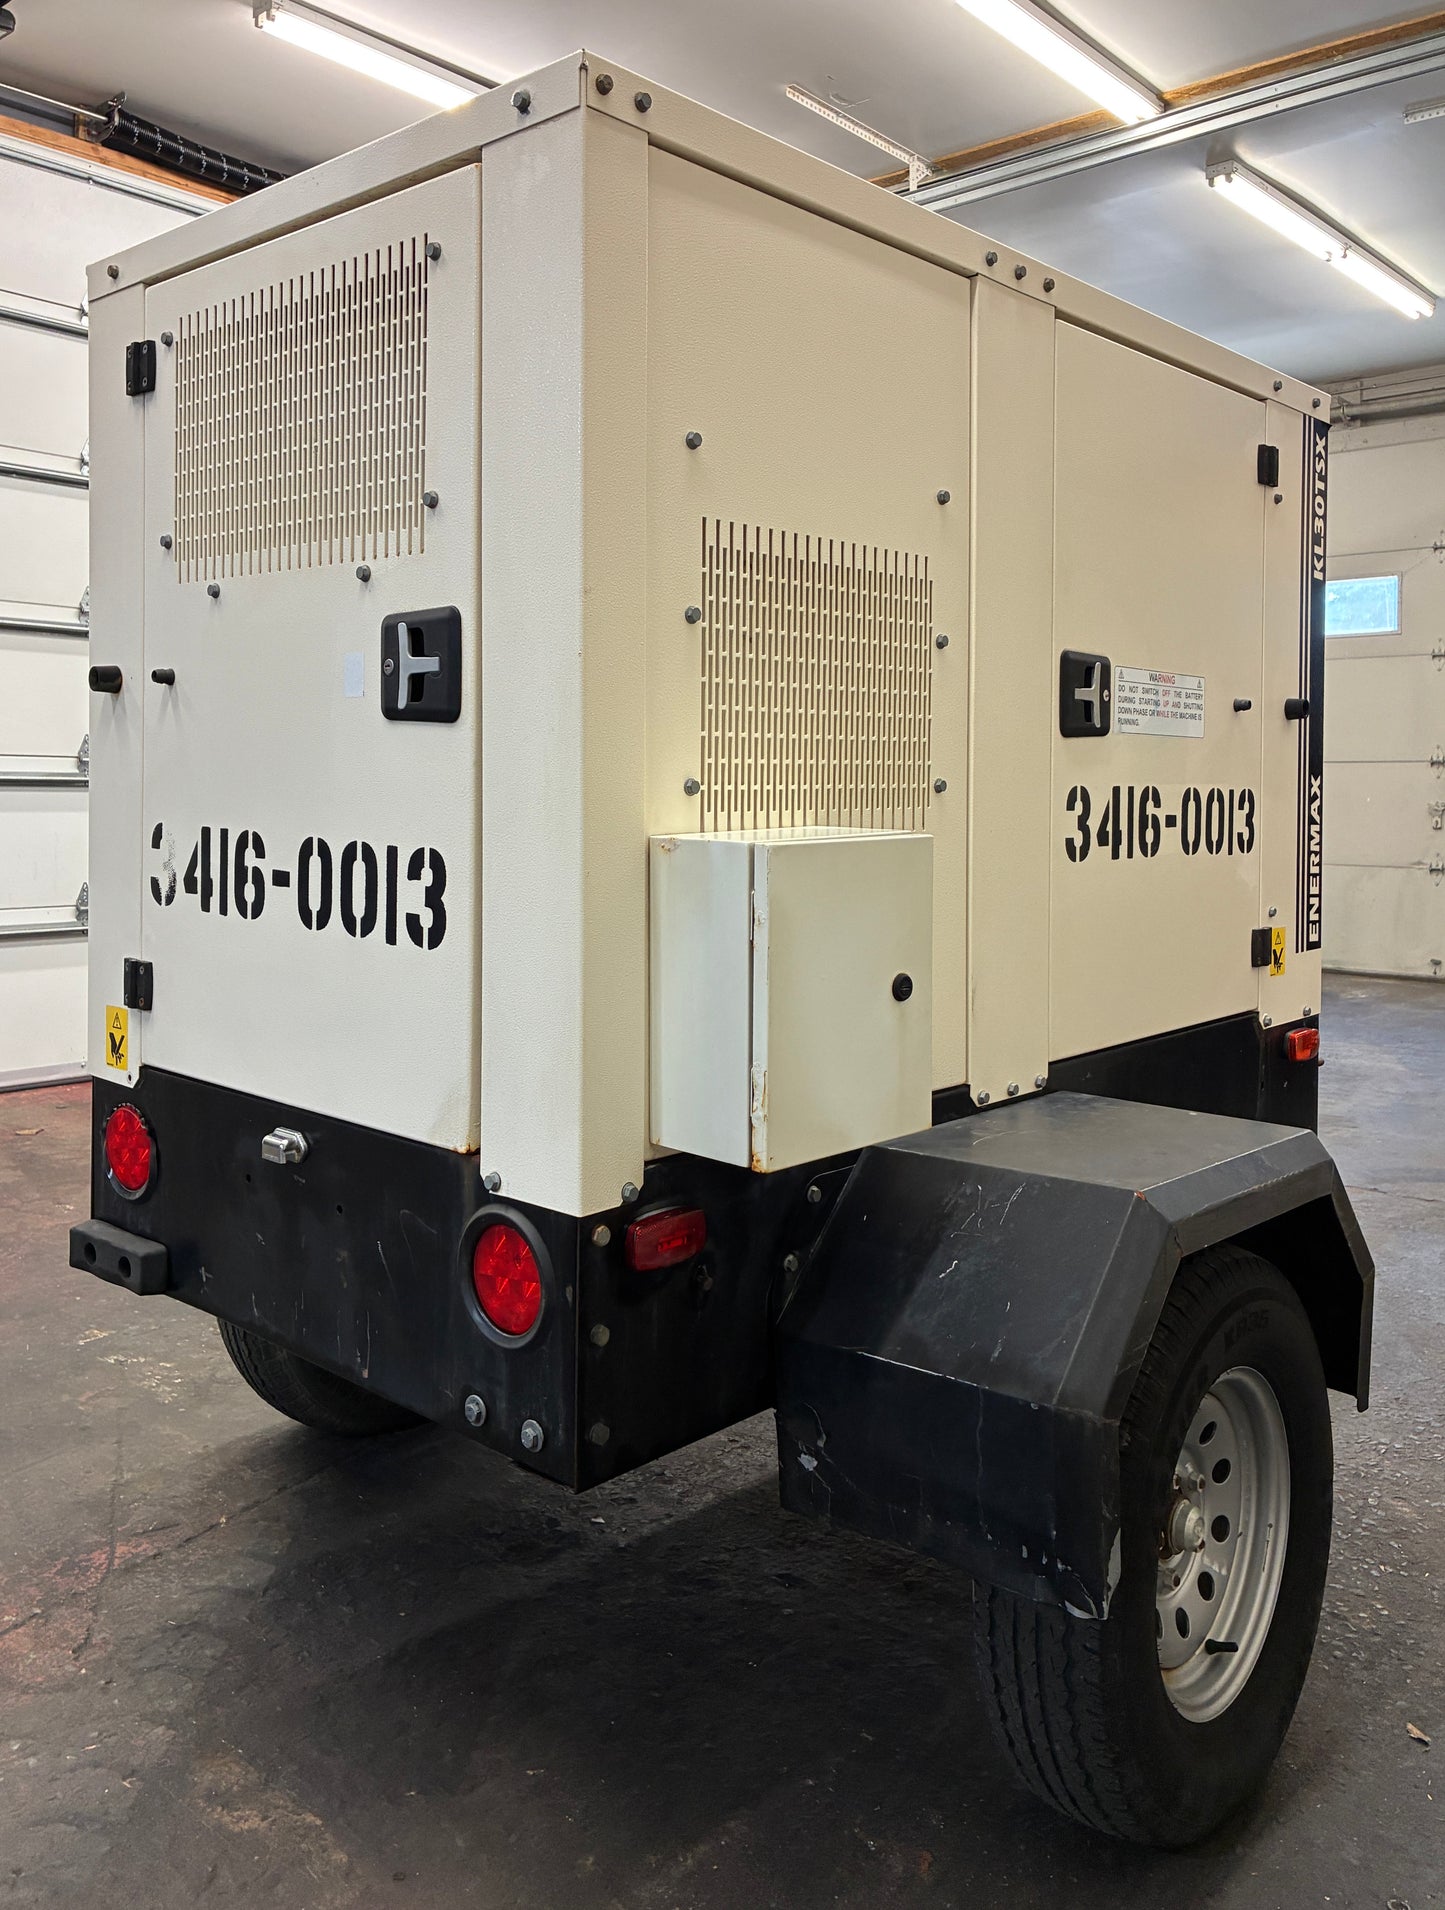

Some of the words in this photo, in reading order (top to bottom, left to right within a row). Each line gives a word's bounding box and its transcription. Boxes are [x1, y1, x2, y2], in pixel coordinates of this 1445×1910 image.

[1313, 432, 1326, 581] KL30TSX
[1118, 684, 1125, 692] DO
[1129, 685, 1138, 693] NOT
[1142, 687, 1159, 696] SWITCH
[1162, 689, 1170, 697] OFF
[1174, 690, 1182, 698] THE
[1185, 691, 1203, 700] BATTERY
[1149, 672, 1175, 685] WARNING
[1118, 695, 1135, 704] DURING
[1139, 697, 1160, 707] STARTING
[1184, 702, 1203, 711] SHUTTING
[1118, 706, 1132, 715] DOWN
[1133, 708, 1148, 716] PHASE
[1149, 709, 1155, 717] OR
[1156, 710, 1169, 718] WHILE
[1179, 712, 1197, 720] MACHINE
[1065, 785, 1255, 863] 3416-0013
[1308, 774, 1321, 942] ENERMAX
[150, 822, 447, 951] 3416-0013
